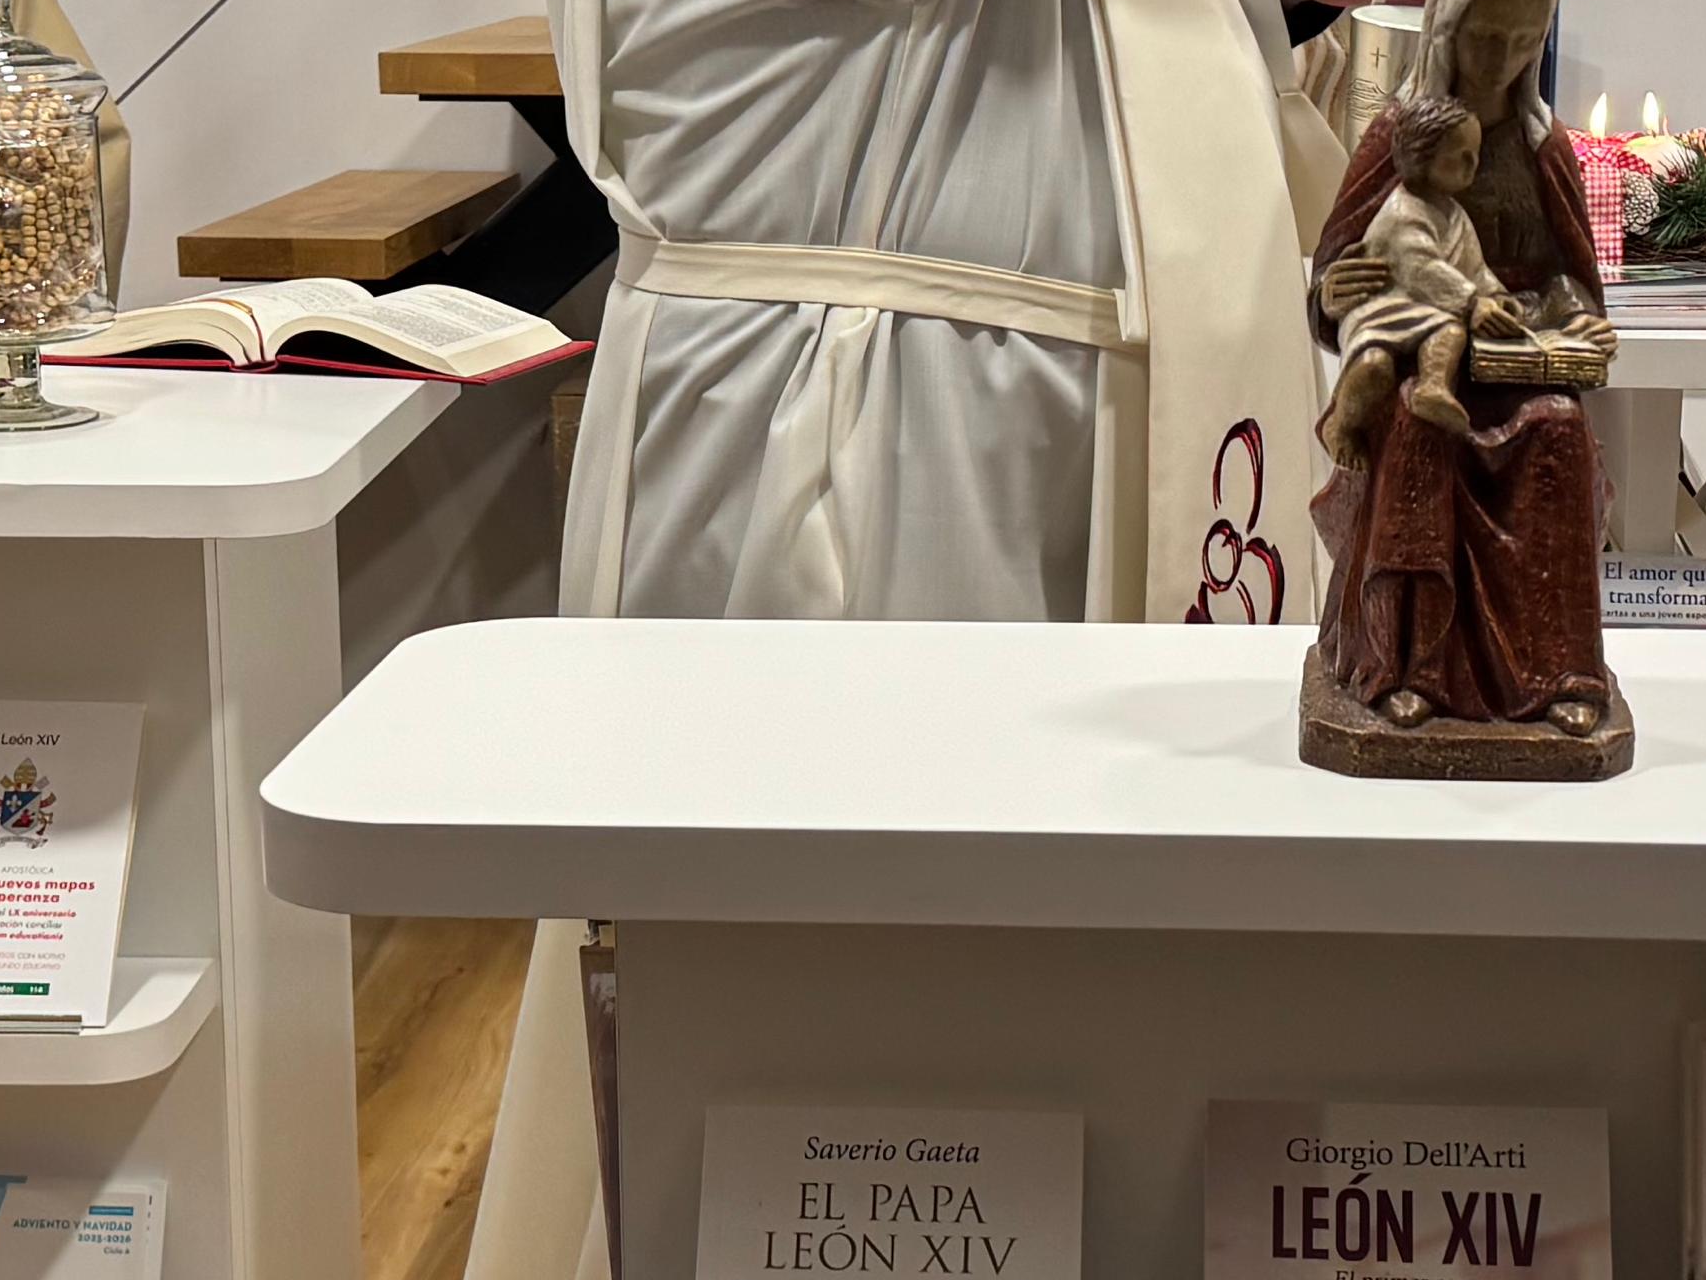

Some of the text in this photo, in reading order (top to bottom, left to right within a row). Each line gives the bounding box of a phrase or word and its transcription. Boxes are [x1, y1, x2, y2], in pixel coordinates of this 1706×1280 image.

[1604, 562, 1622, 580] El
[1629, 568, 1677, 581] amor
[0, 733, 61, 748] León XIV
[45, 881, 95, 892] mapas
[805, 1136, 980, 1163] Saverio Gaeta
[1286, 1138, 1393, 1170] Giorgio
[799, 1182, 988, 1224] EL PAPA
[13, 1219, 132, 1232] ADVIENTO Y NAVIDAD
[1272, 1172, 1542, 1267] LEÓN XIV
[765, 1225, 1019, 1276] LEÓN XIV
